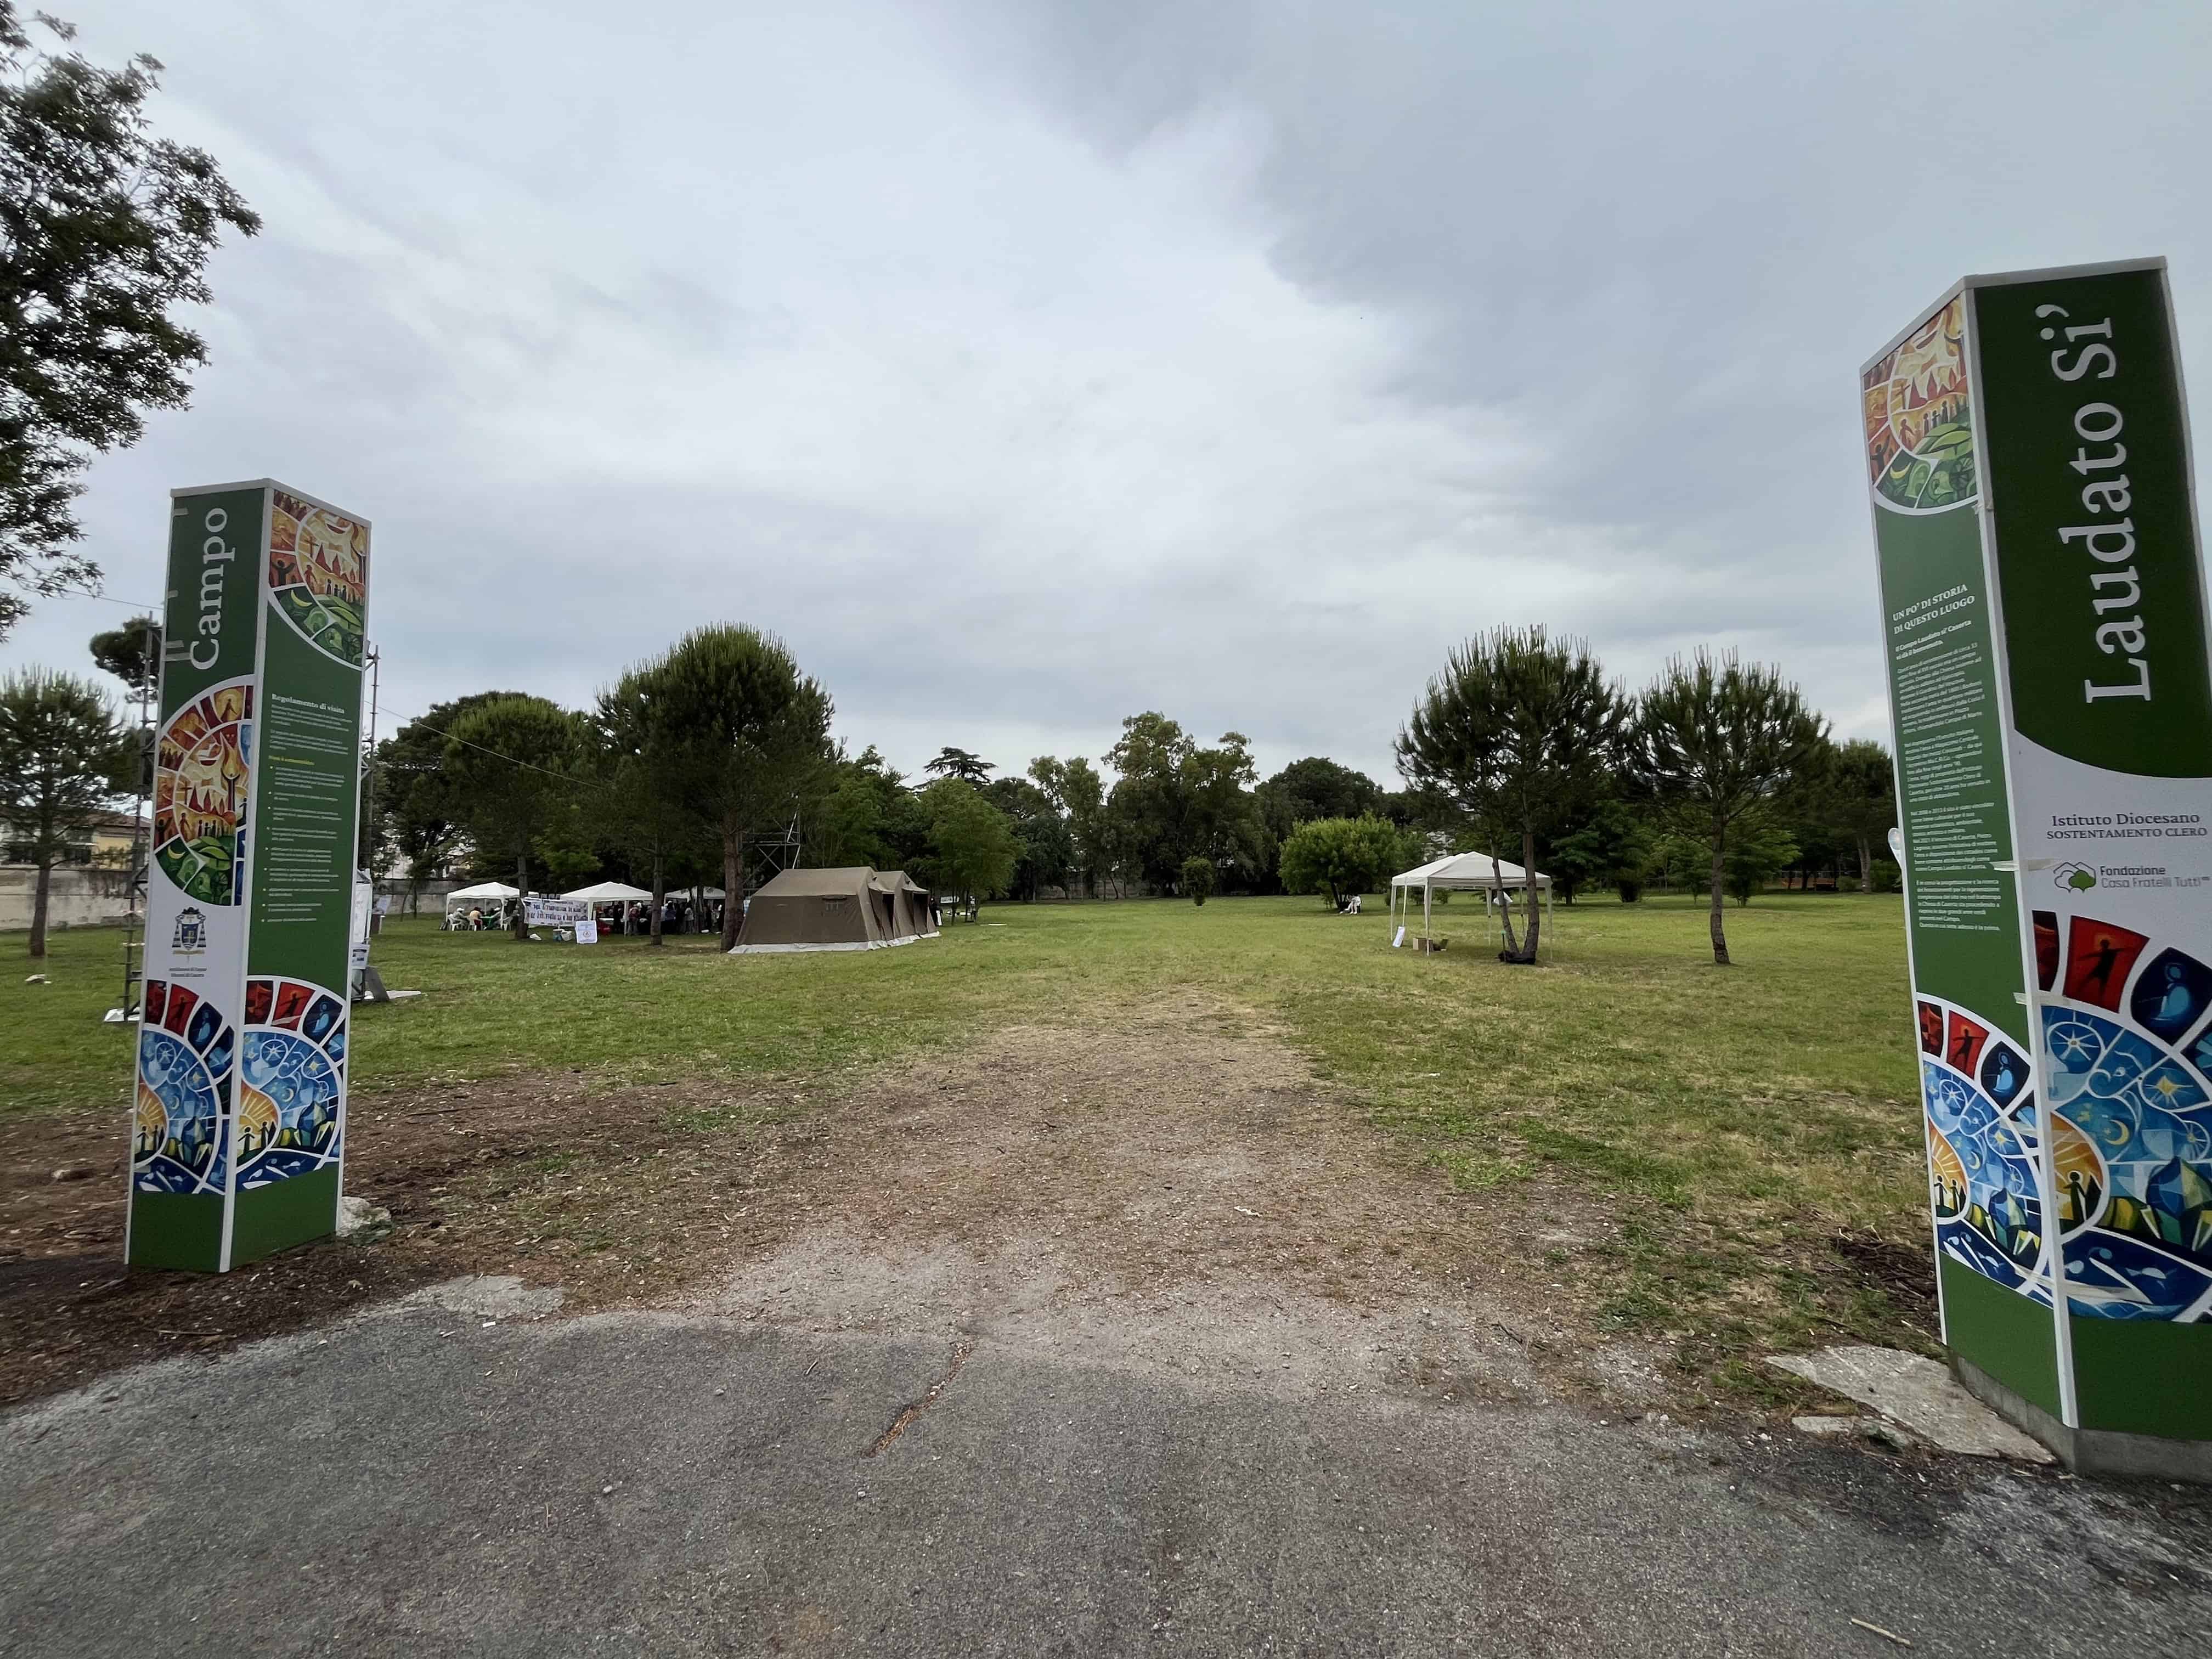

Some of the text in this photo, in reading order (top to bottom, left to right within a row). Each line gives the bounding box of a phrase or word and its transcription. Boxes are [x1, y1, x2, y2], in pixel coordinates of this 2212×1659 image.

[2058, 402, 2151, 703] Laudato
[189, 508, 235, 670] Campo
[1893, 610, 1905, 621] UN
[1920, 597, 1931, 610] DI
[1932, 584, 1968, 605] STORIA
[1894, 595, 1975, 634] DI QUESTO LUOGO
[272, 693, 318, 708] Regolamento
[327, 704, 345, 713] visita
[2052, 812, 2200, 826] Istituto Diocesano
[2047, 827, 2208, 839] SOSTENTAMENTO CLERO
[2100, 866, 2166, 876] Fondazione
[2101, 878, 2129, 888] Casa
[2133, 877, 2172, 888] Fratelli
